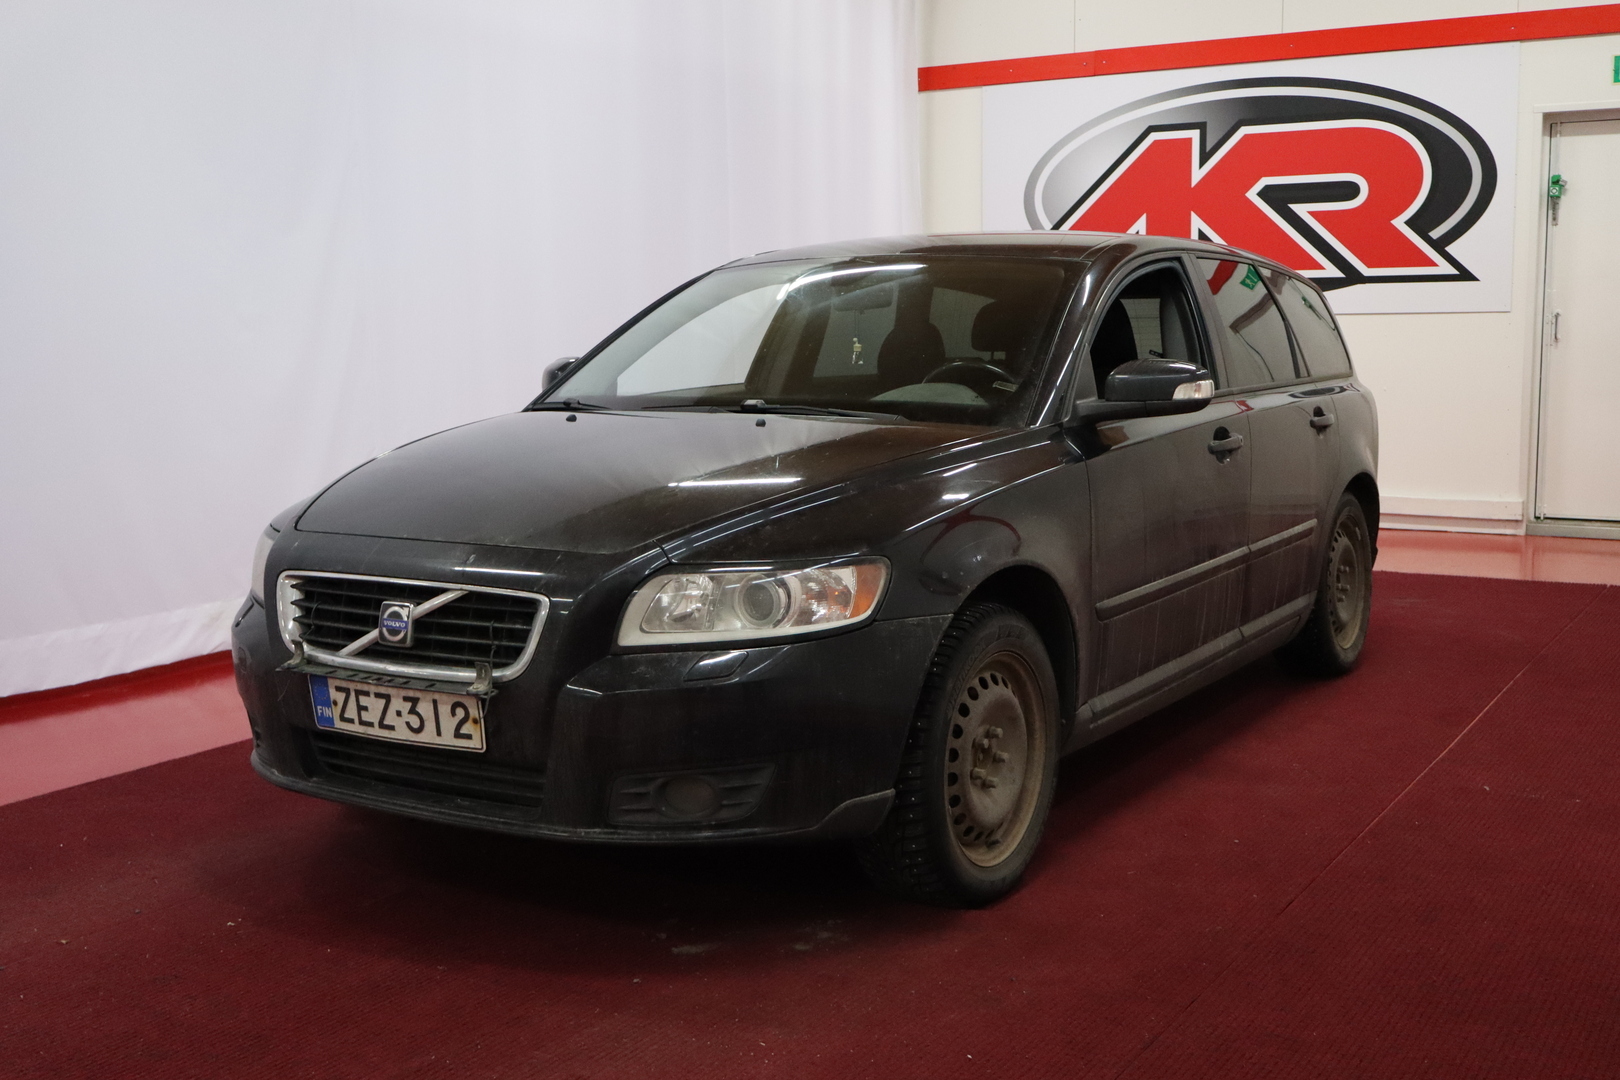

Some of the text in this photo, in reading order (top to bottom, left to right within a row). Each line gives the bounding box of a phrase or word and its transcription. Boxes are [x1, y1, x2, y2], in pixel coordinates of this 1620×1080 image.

[383, 620, 406, 628] VOLVO
[317, 706, 333, 718] FIN
[335, 687, 473, 740] ZEZ-312
